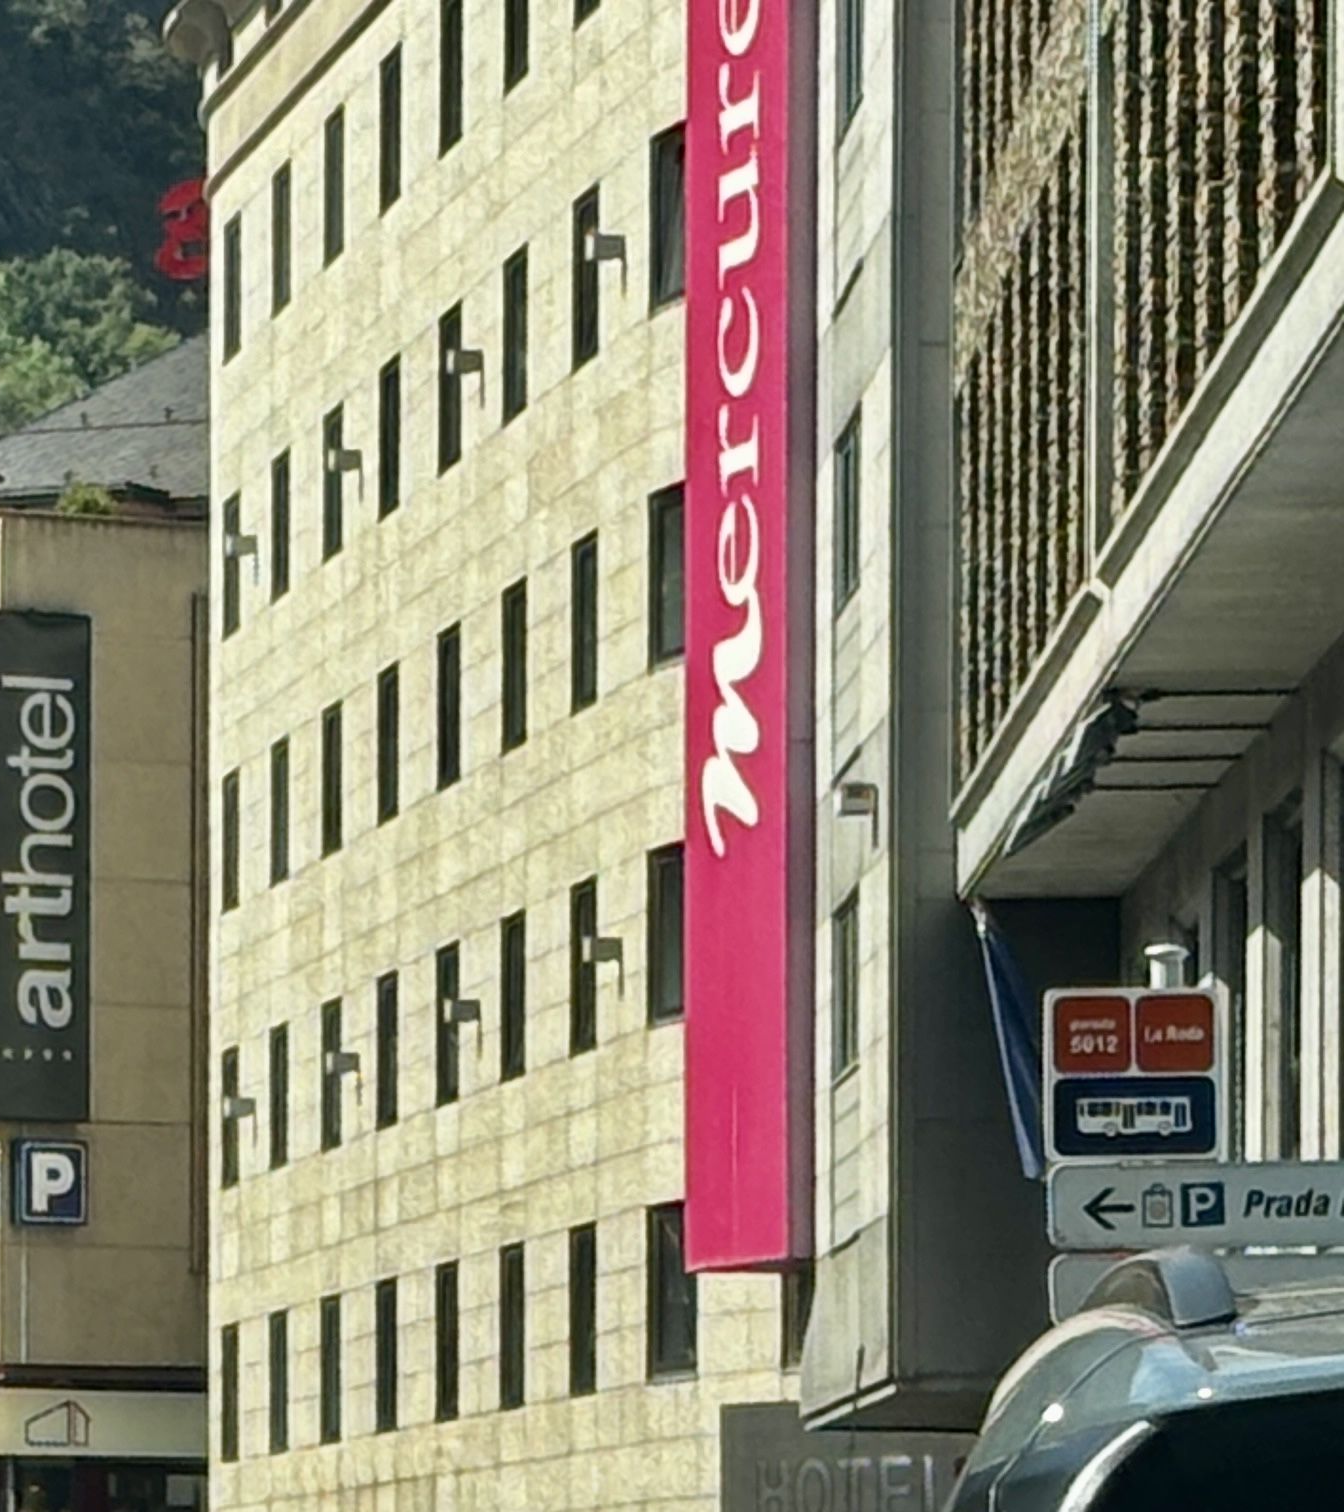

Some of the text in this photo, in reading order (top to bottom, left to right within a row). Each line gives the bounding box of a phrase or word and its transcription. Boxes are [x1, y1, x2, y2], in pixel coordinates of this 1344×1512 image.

[1, 674, 76, 1030] arthotel
[31, 1151, 76, 1213] P
[1243, 1187, 1331, 1219] Prada
